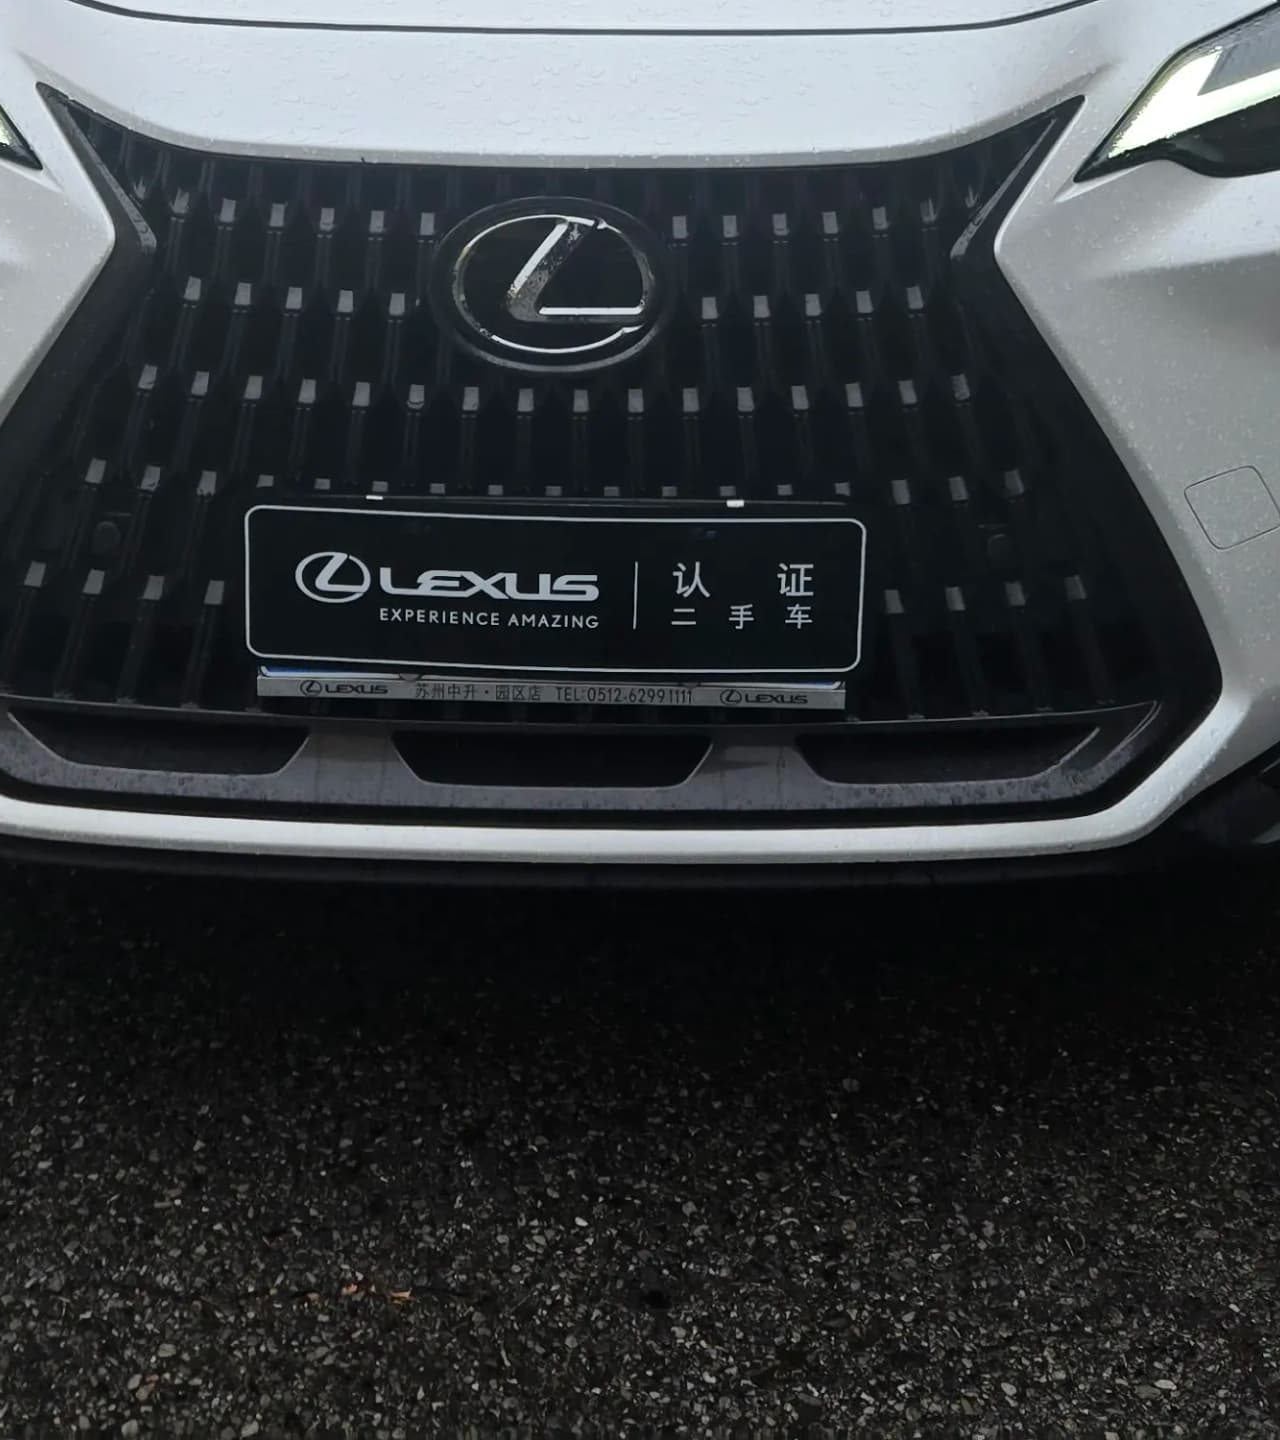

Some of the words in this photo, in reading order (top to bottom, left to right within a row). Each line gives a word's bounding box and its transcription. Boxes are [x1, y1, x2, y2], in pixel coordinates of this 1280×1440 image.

[380, 566, 599, 601] LEXUS
[672, 561, 814, 598] 认证
[379, 608, 500, 626] EXPERIENCE
[507, 613, 599, 629] AMAZING
[671, 603, 813, 630] 二手车
[325, 683, 388, 695] LEXUS
[745, 693, 808, 705] LEXUS
